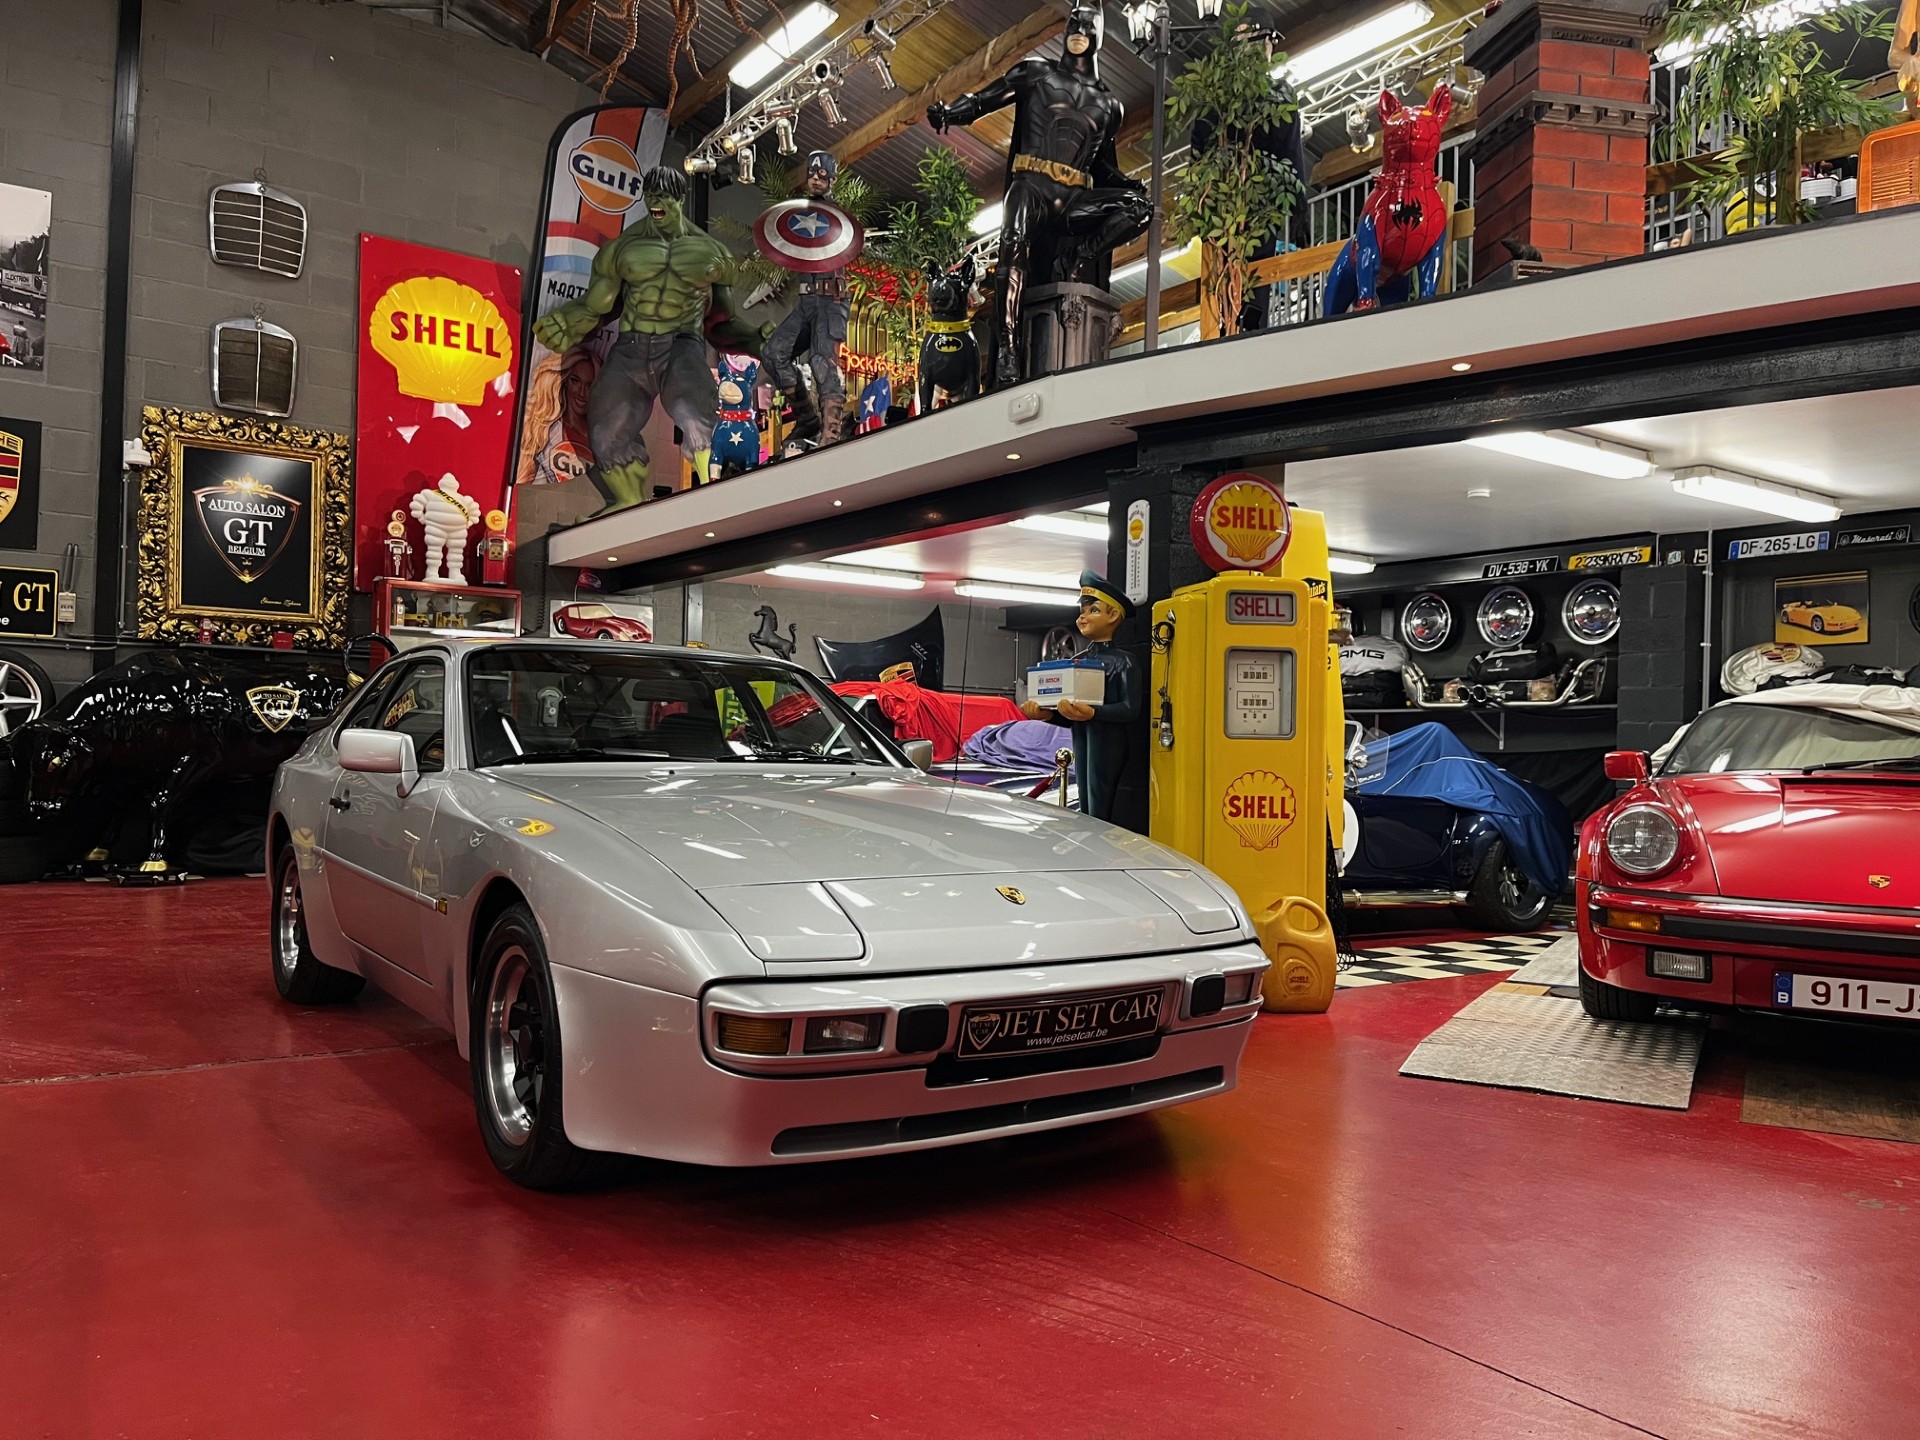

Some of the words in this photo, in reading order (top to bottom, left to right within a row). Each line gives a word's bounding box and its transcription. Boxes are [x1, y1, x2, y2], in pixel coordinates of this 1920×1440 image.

[811, 156, 822, 167] A
[572, 153, 642, 197] Gulf
[547, 278, 588, 300] MART
[390, 310, 502, 359] SHELL
[207, 498, 243, 512] AUTO
[246, 502, 286, 517] SALON
[1216, 505, 1278, 532] SHELL
[223, 517, 273, 547] GT
[227, 545, 266, 555] BELGIUM
[1740, 534, 1816, 555] DF-265-LG
[1487, 558, 1550, 578] DV-538-YK
[13, 581, 50, 613] GT
[1234, 596, 1286, 618] SHELL
[1338, 648, 1386, 660] AMG
[263, 699, 289, 714] GT
[1228, 794, 1291, 820] SHELL
[1777, 991, 1789, 1003] B
[1810, 980, 1920, 1013] 911-J
[998, 1008, 1050, 1038] JET
[1055, 1002, 1106, 1032] SET
[1109, 994, 1159, 1024] CAR
[1026, 1027, 1109, 1047] www.jetsetcar.be
